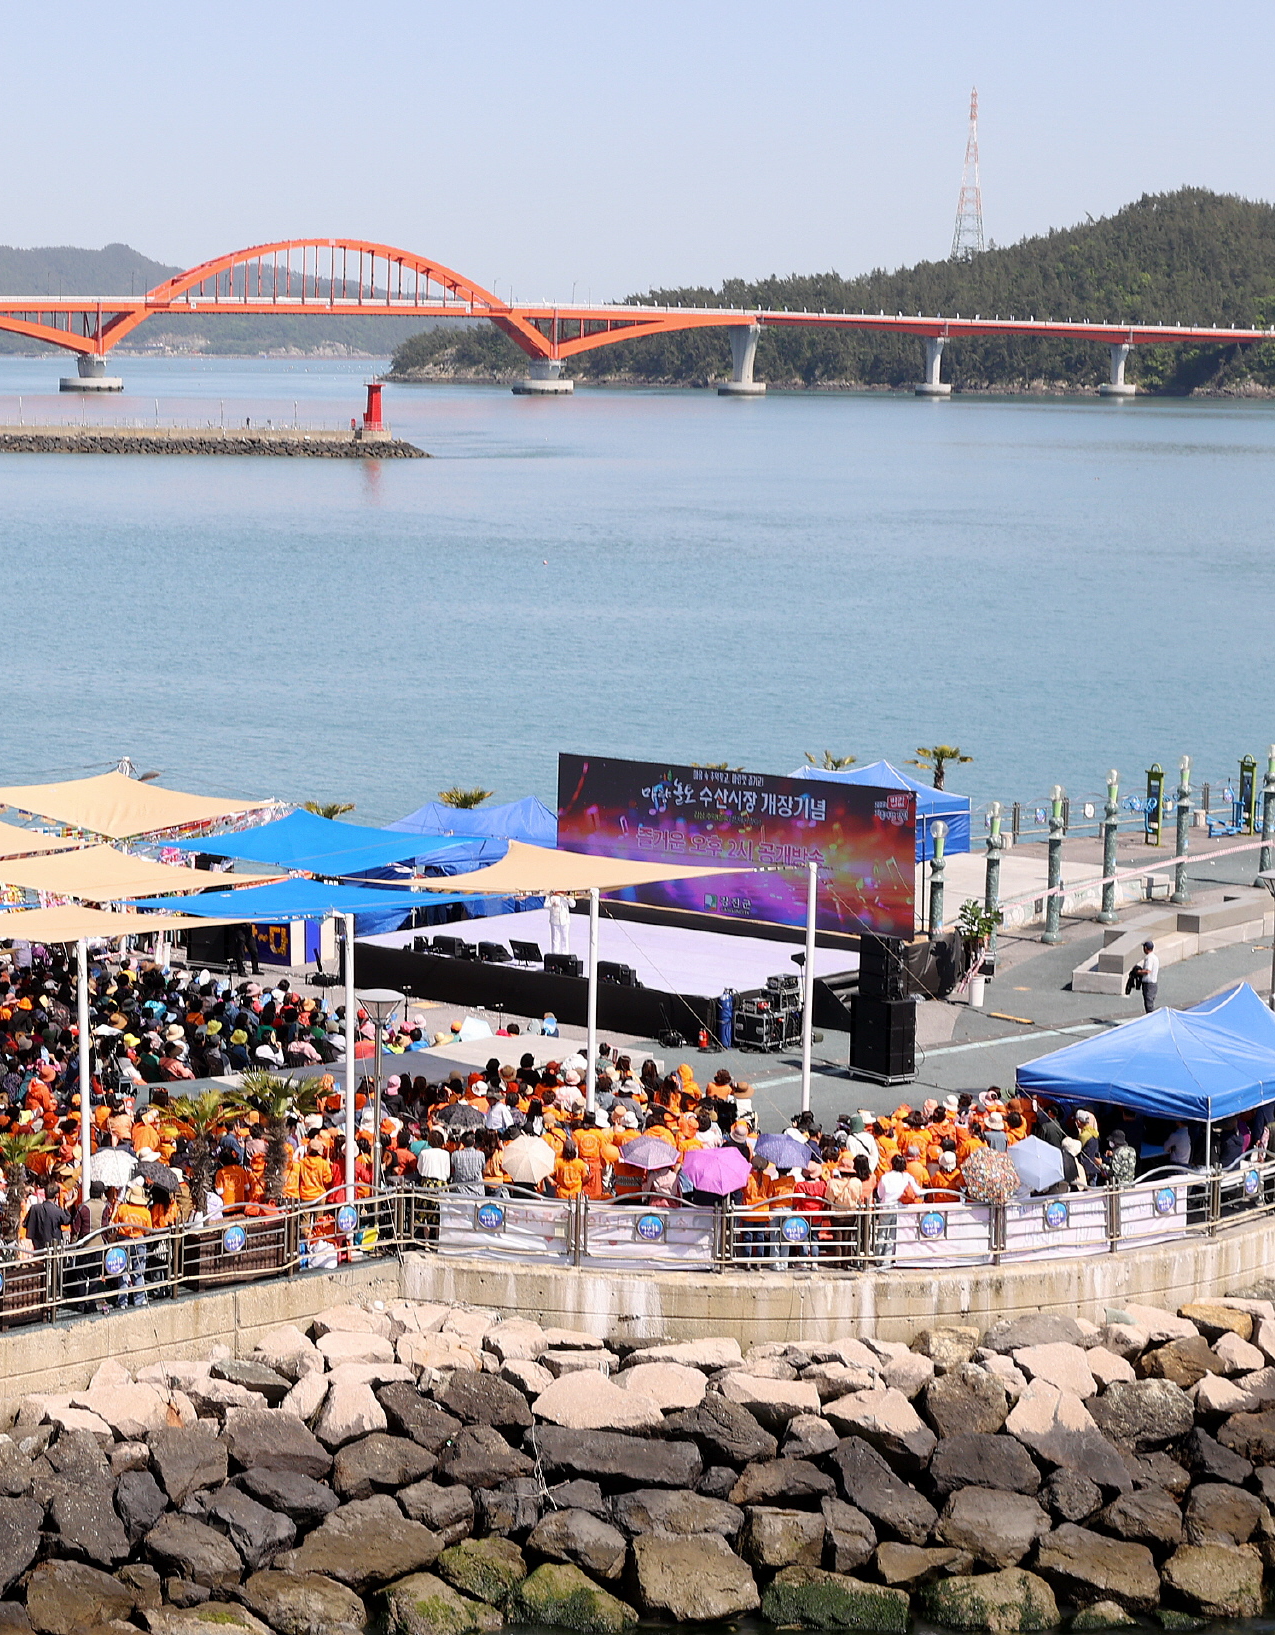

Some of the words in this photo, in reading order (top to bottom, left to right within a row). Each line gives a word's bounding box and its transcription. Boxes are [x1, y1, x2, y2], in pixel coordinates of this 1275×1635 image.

[699, 786, 758, 814] 수산시장
[761, 791, 827, 821] 개장기념
[635, 826, 687, 852] 즐거운
[689, 834, 723, 857] 오후
[727, 839, 754, 862] 2시
[757, 841, 826, 867] 공개방송
